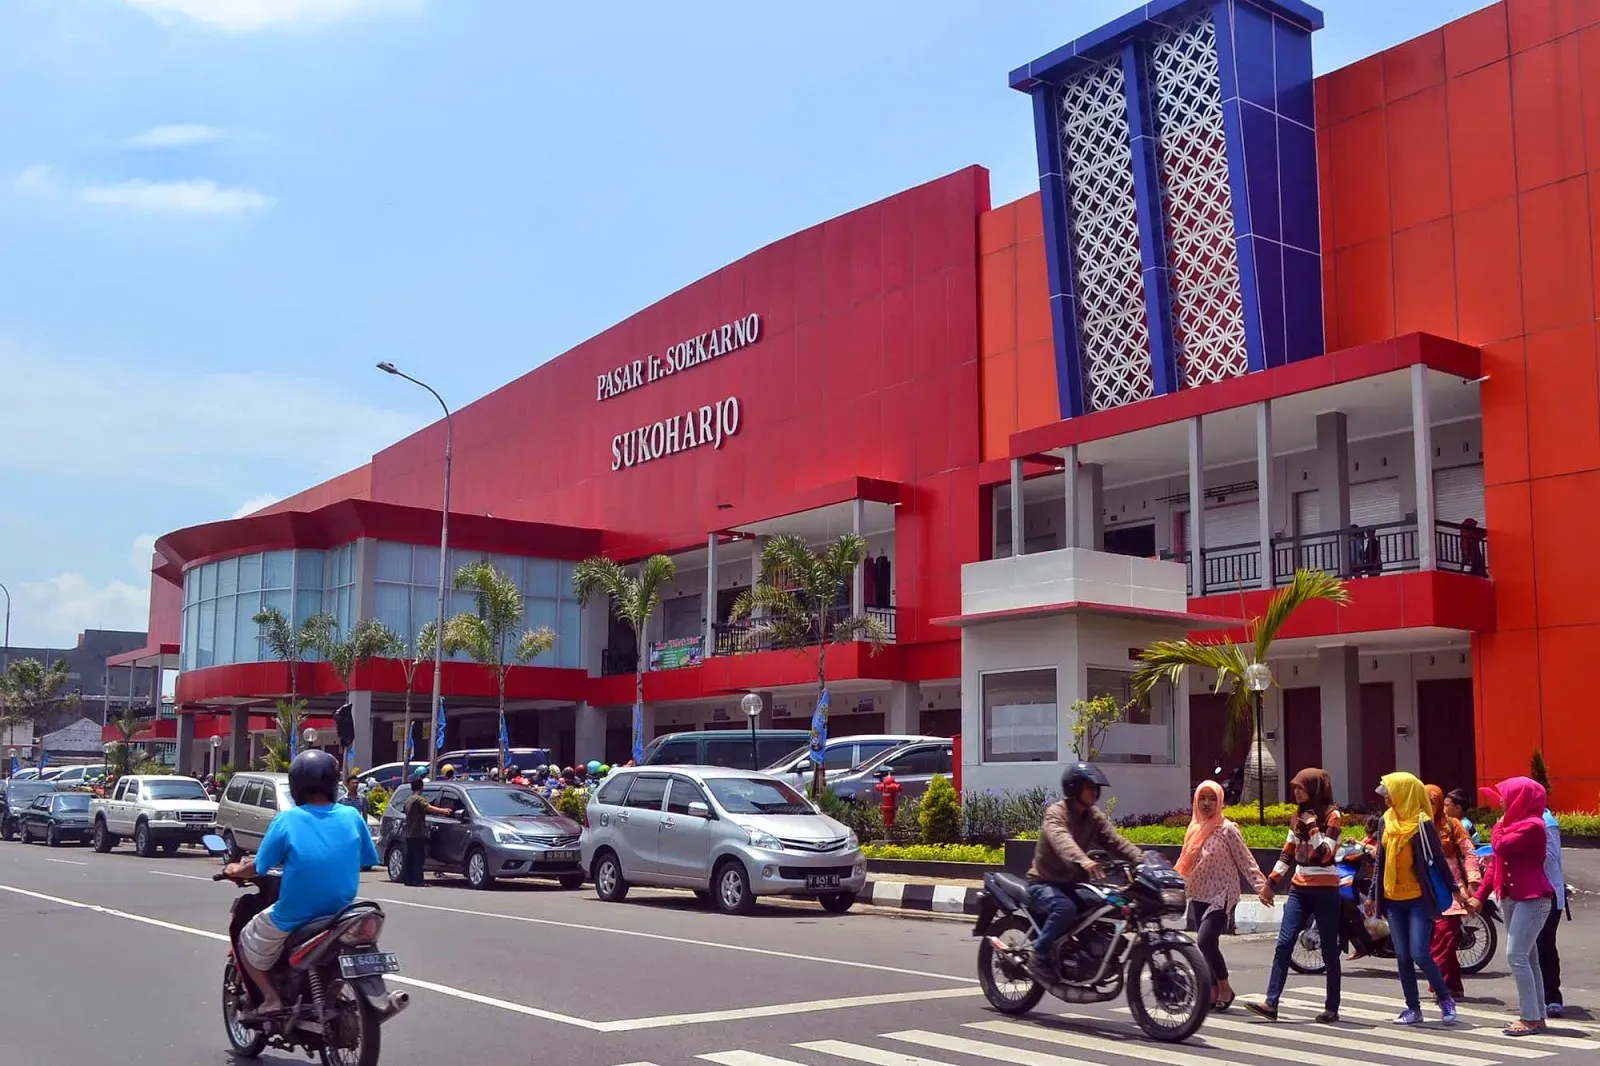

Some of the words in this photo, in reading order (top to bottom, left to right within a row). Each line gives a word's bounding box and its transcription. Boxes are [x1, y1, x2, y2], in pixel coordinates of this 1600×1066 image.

[597, 360, 643, 401] PASAR
[666, 313, 759, 375] SOEKARNO
[611, 396, 739, 471] SUKOHARJO
